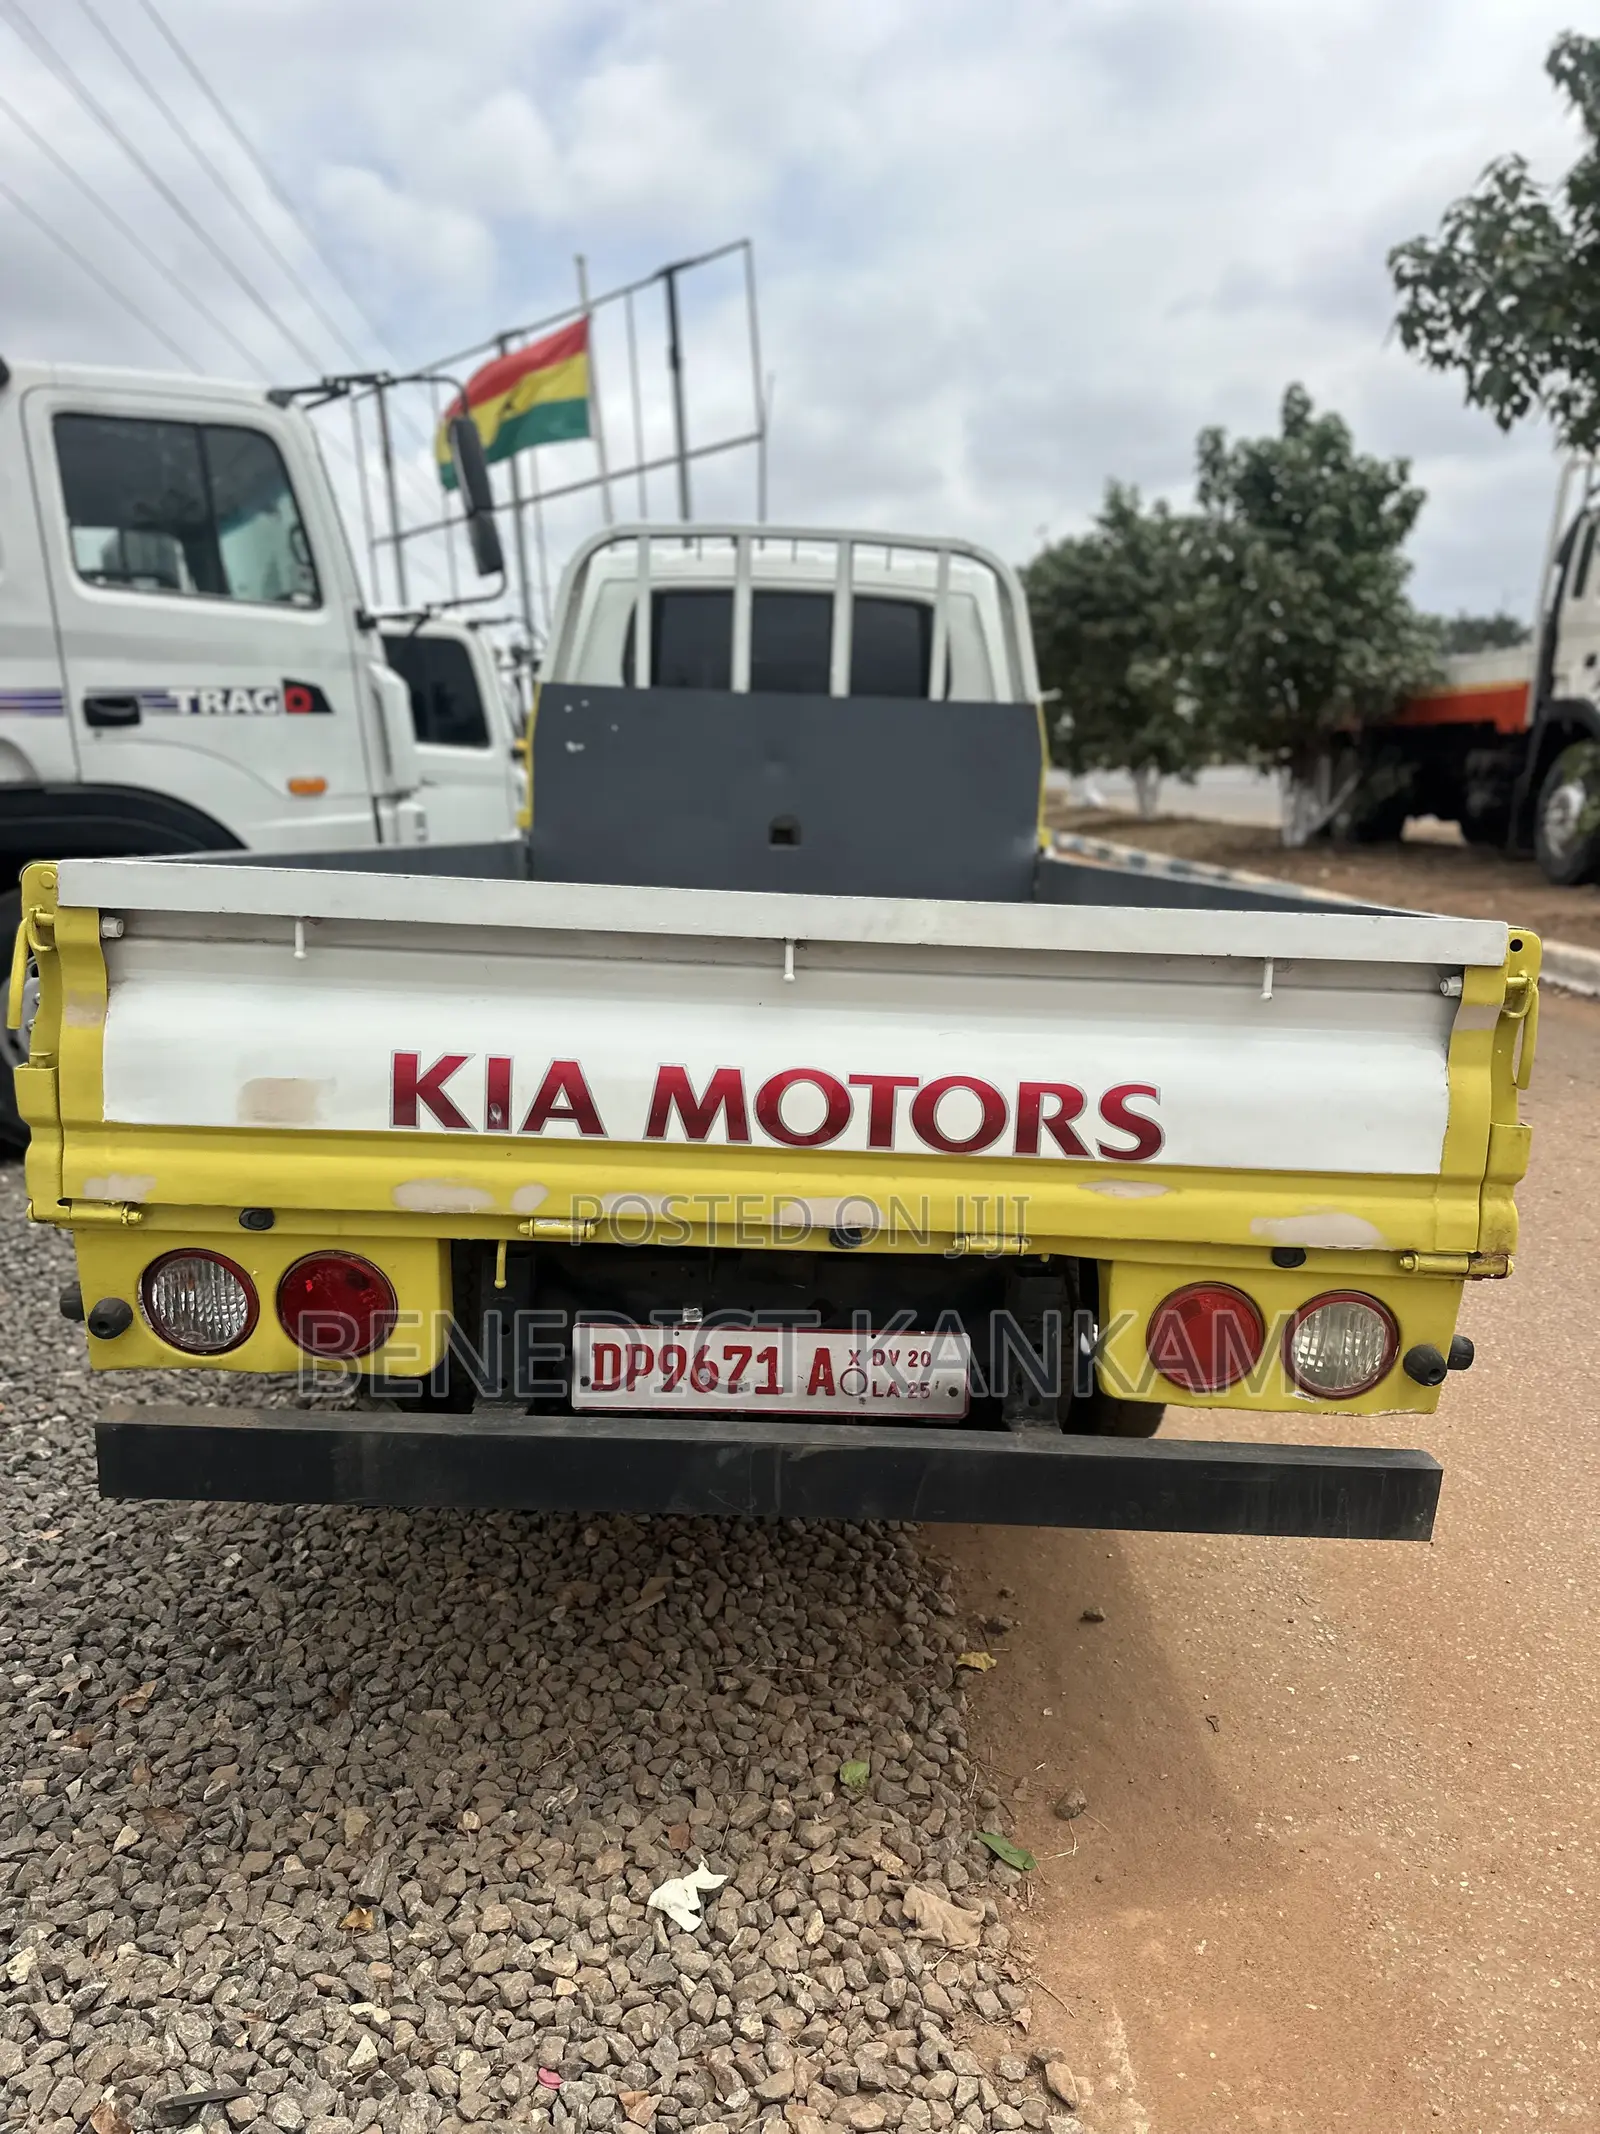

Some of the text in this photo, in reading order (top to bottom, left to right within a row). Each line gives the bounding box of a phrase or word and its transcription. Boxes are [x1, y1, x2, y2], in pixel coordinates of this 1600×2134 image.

[390, 1049, 1165, 1162] KIA MOTORS
[591, 1342, 836, 1396] DP9671 A
[907, 1349, 932, 1368] 20
[872, 1380, 931, 1399] LA 25
